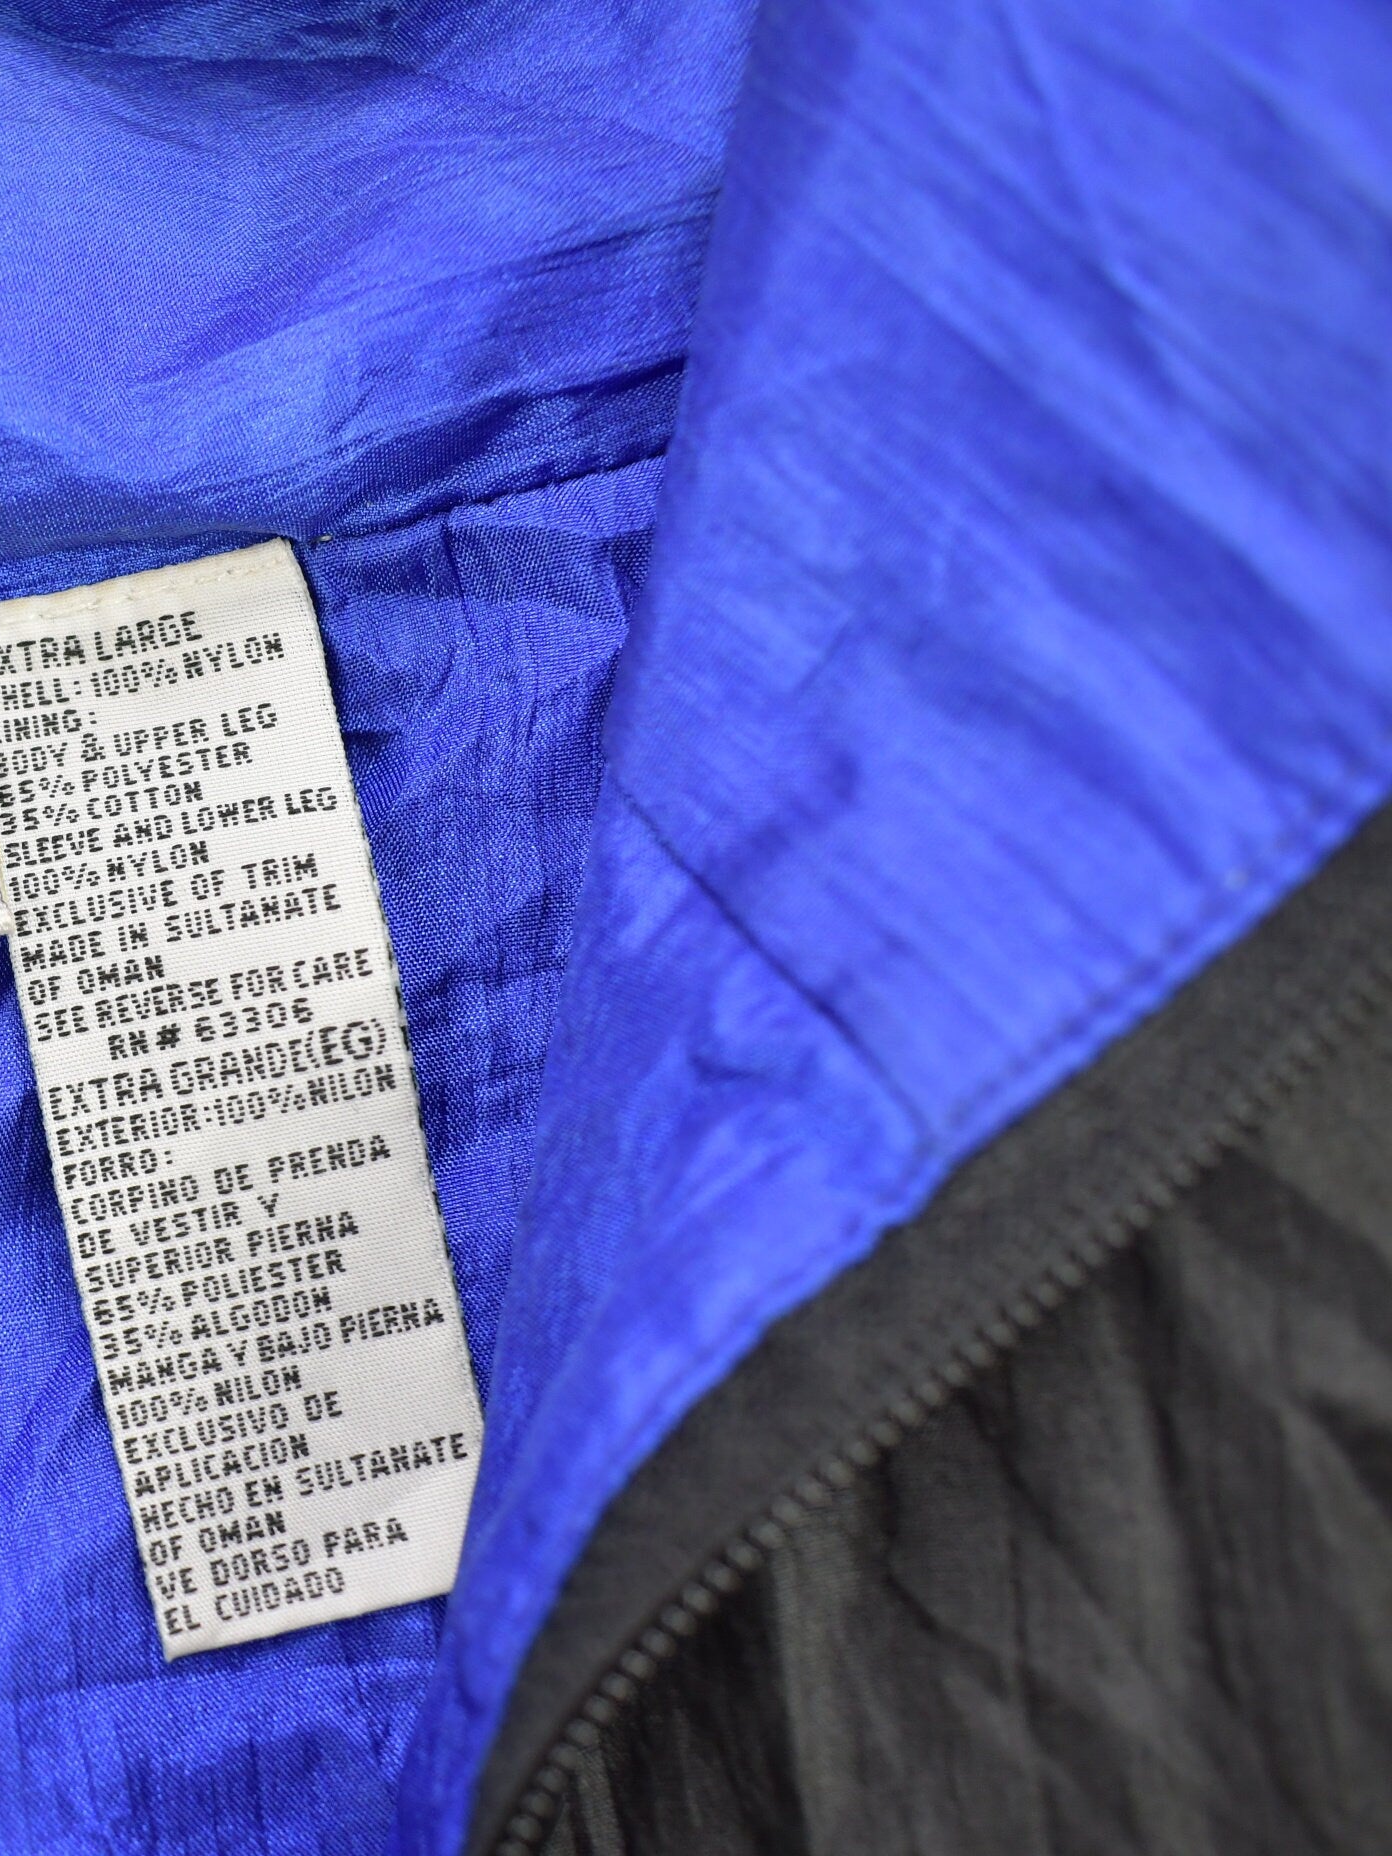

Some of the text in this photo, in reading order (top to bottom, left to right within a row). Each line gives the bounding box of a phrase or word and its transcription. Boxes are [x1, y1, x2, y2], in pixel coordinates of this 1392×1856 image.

[94, 611, 202, 661] LARGE
[183, 633, 284, 679] NYLON
[81, 733, 106, 762] &
[114, 719, 209, 756] UPPER
[221, 703, 277, 736] LEG
[81, 742, 252, 792] POLYESTER
[0, 781, 203, 835] 35% COTTON
[4, 787, 337, 868] SLEEVE AND LOWER LEG
[106, 841, 209, 882] NYLON
[14, 853, 318, 937] EXCLUSIVE OF TRIM
[21, 884, 341, 972] MADE IN SULTANATE
[28, 955, 164, 1005] OF OMAN
[34, 948, 372, 1041] SEE REVERSE FOR CARE
[195, 998, 313, 1042] 63306
[49, 1068, 163, 1120] EXTRA
[63, 1147, 173, 1189] FORRO:
[71, 1135, 391, 1224] CORPINO DE PRENDA
[78, 1193, 279, 1258] DE VESTIR Y
[85, 1211, 359, 1292] SUPERIOR PIERNA
[93, 1250, 346, 1325] 65% POLIESTER
[100, 1287, 332, 1359] 35% ALGODON
[108, 1298, 444, 1395] MANGA Y BAJO PIERNA
[214, 1365, 301, 1406] NILON
[124, 1391, 342, 1464] EXCLUSIVO DE
[135, 1434, 309, 1497] APLICACION
[140, 1433, 467, 1533] HECHO EN SULTANATE
[150, 1511, 286, 1566] OF OMAN
[156, 1518, 408, 1599] VE DORSO PARA
[165, 1568, 344, 1634] EL CUIDADO
